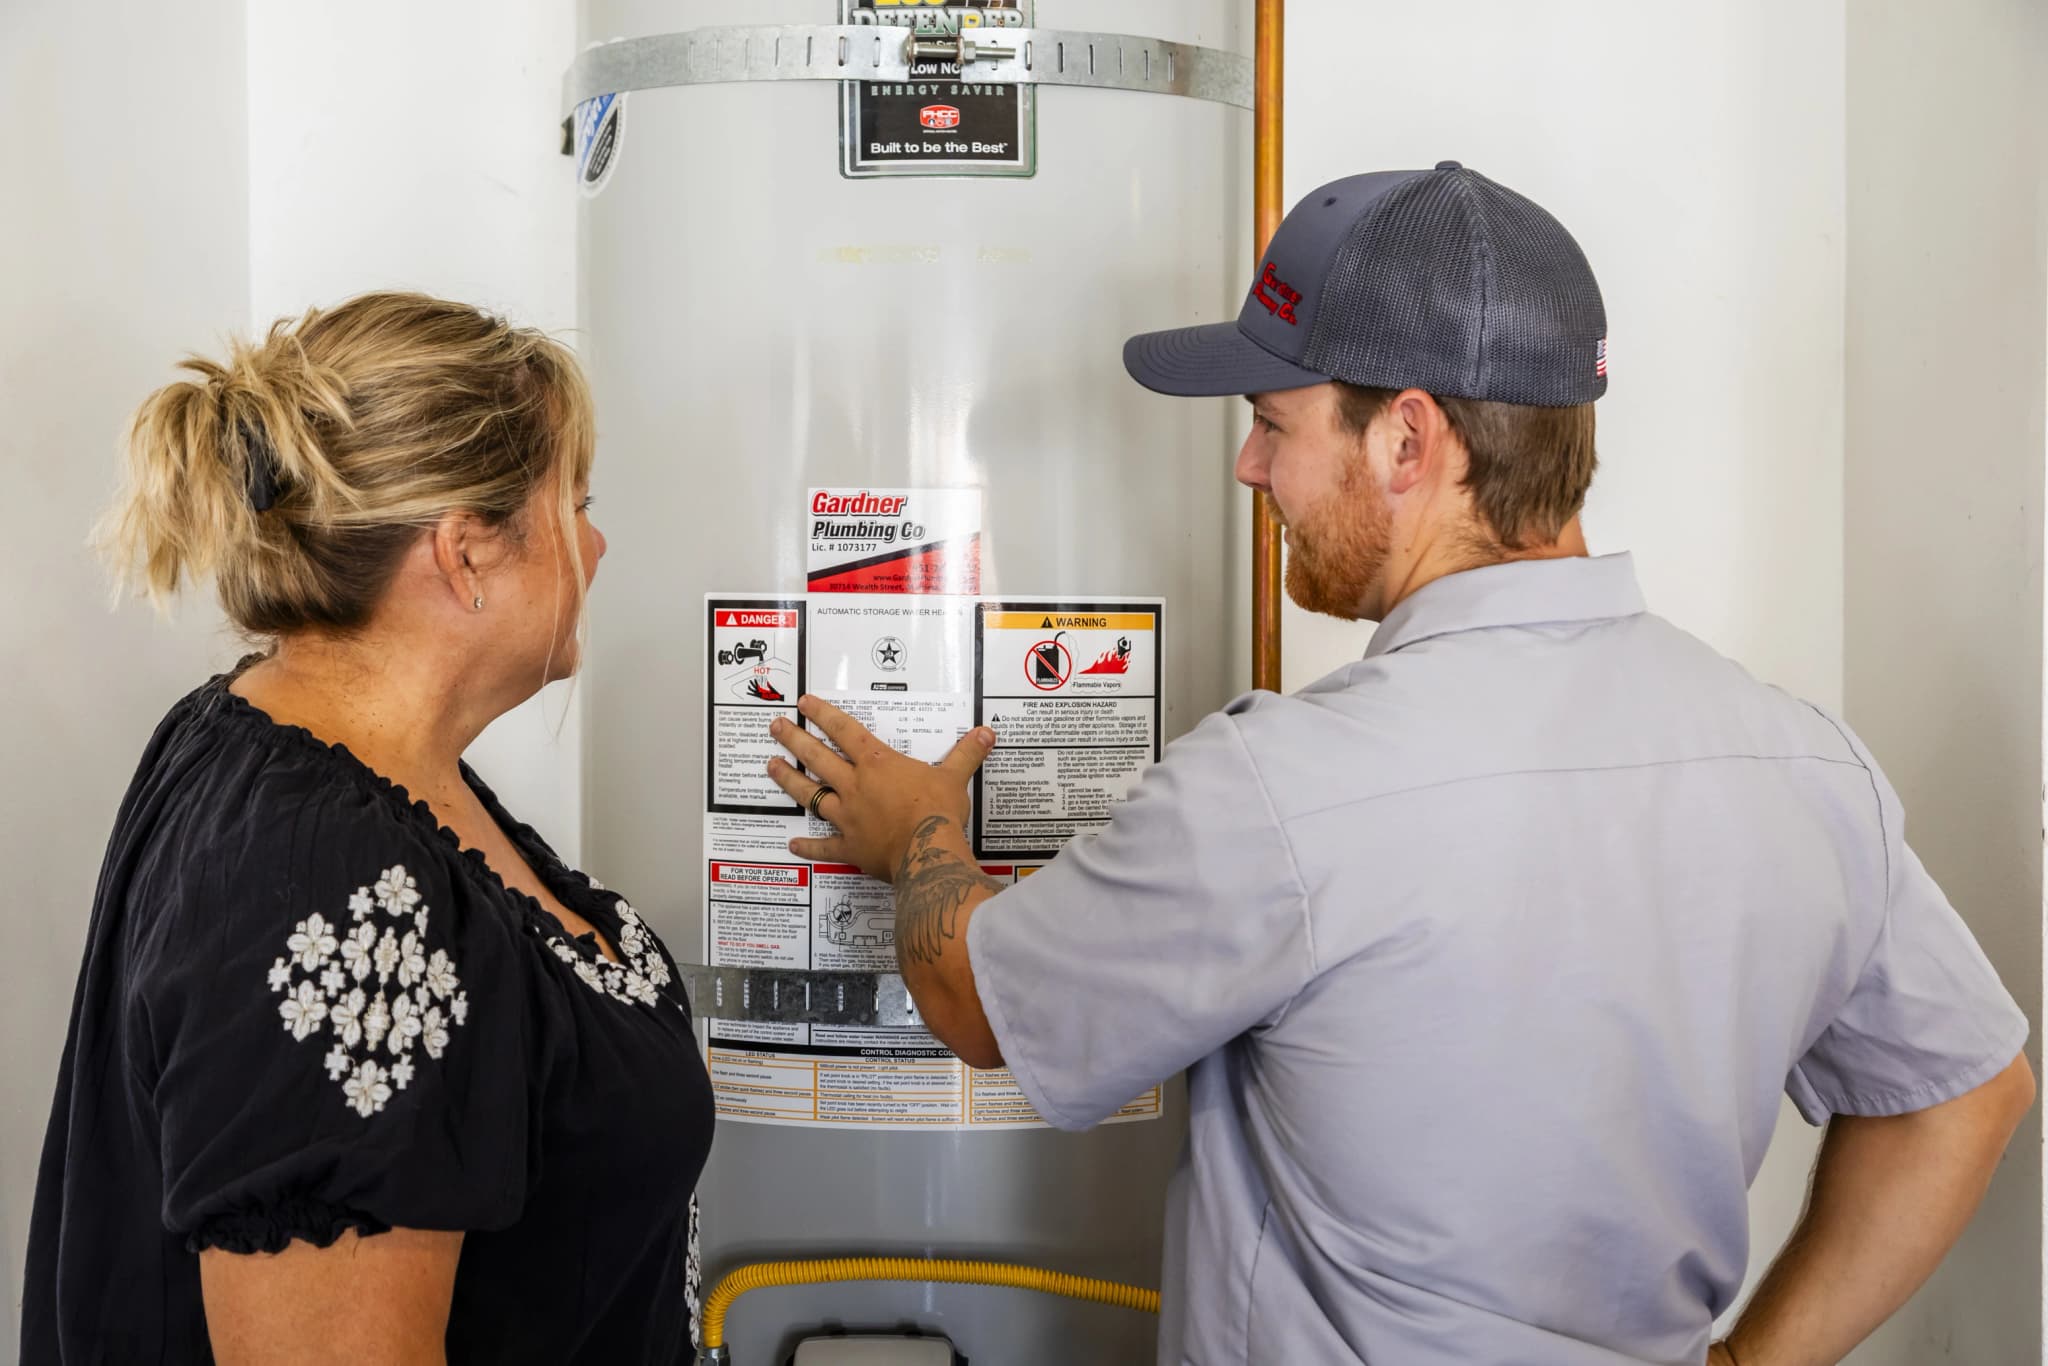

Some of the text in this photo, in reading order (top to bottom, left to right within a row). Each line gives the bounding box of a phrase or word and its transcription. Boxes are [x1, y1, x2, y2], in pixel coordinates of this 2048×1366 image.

[852, 8, 1024, 34] DEFENDER
[911, 63, 937, 74] Low
[871, 85, 1004, 96] ENERGY SAVER
[871, 142, 901, 153] Built
[904, 144, 920, 153] to
[923, 142, 941, 153] be
[945, 142, 968, 153] the
[812, 490, 907, 516] Gardner
[811, 521, 925, 542] Plumbing Co
[741, 614, 786, 626] DANGER
[1056, 618, 1107, 627] WARNING
